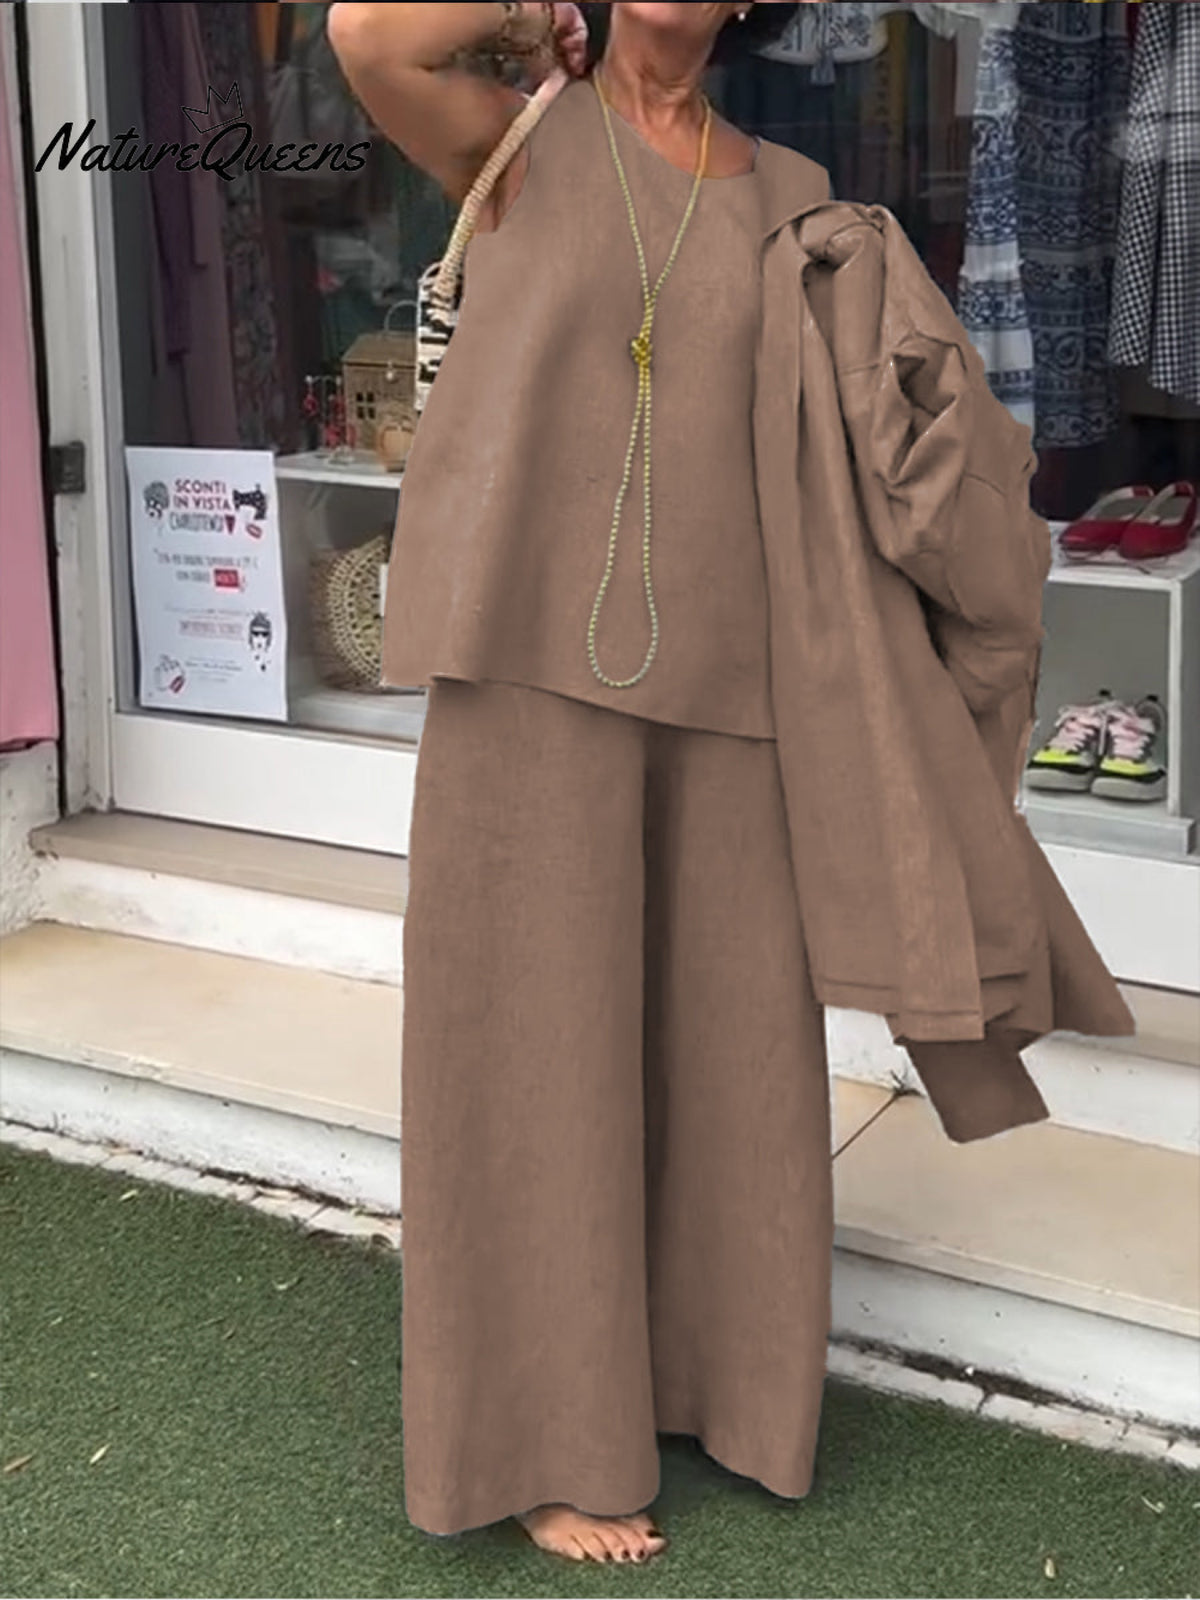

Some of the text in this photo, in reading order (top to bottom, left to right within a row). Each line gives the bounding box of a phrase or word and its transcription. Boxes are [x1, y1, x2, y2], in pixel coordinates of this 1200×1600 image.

[175, 479, 227, 494] SCONTI
[173, 495, 231, 511] IN VISTA
